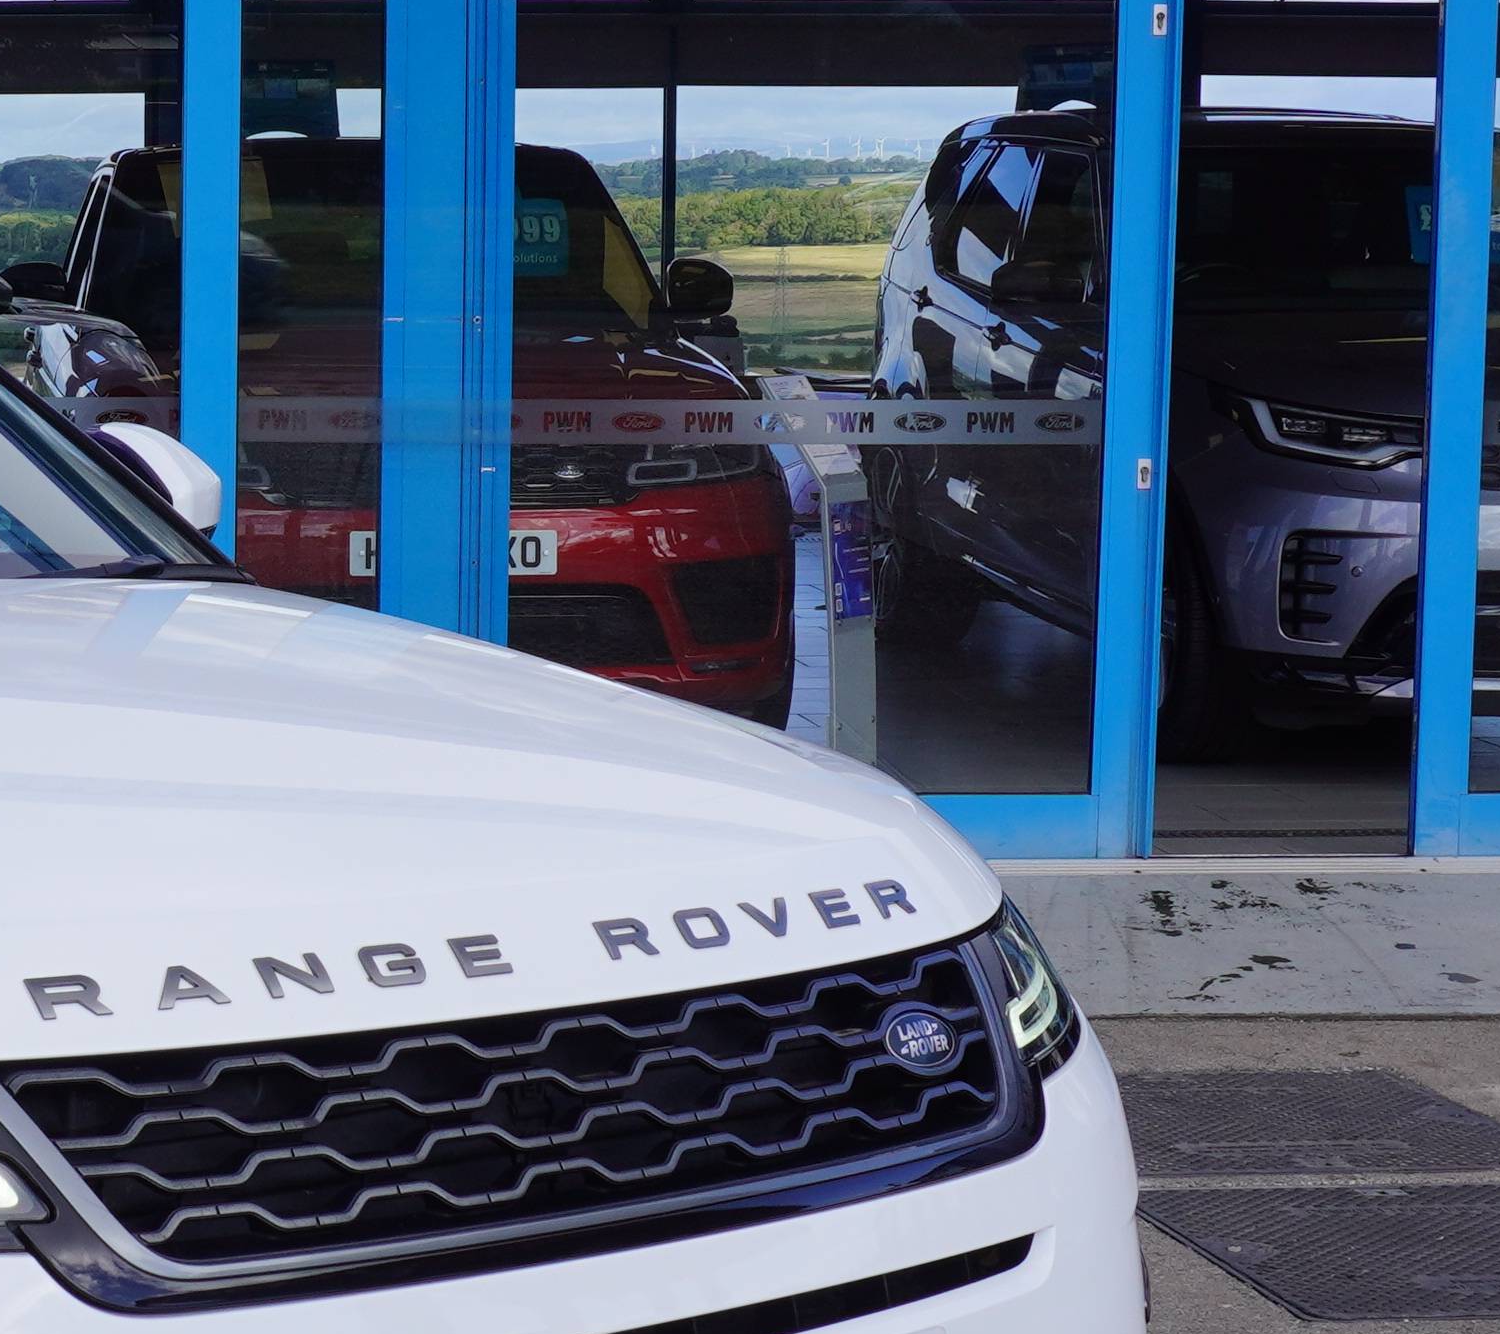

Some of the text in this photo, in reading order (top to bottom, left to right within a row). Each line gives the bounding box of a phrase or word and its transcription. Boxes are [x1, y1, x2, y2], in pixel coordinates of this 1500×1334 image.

[514, 215, 560, 243] 99
[542, 410, 592, 434] PWM
[684, 410, 734, 434] PWM
[825, 411, 875, 434] PWM
[966, 411, 1016, 434] PWM
[22, 877, 919, 1022] RANGE ROVER
[895, 1019, 933, 1042] LAND
[907, 1033, 950, 1058] ROVER
